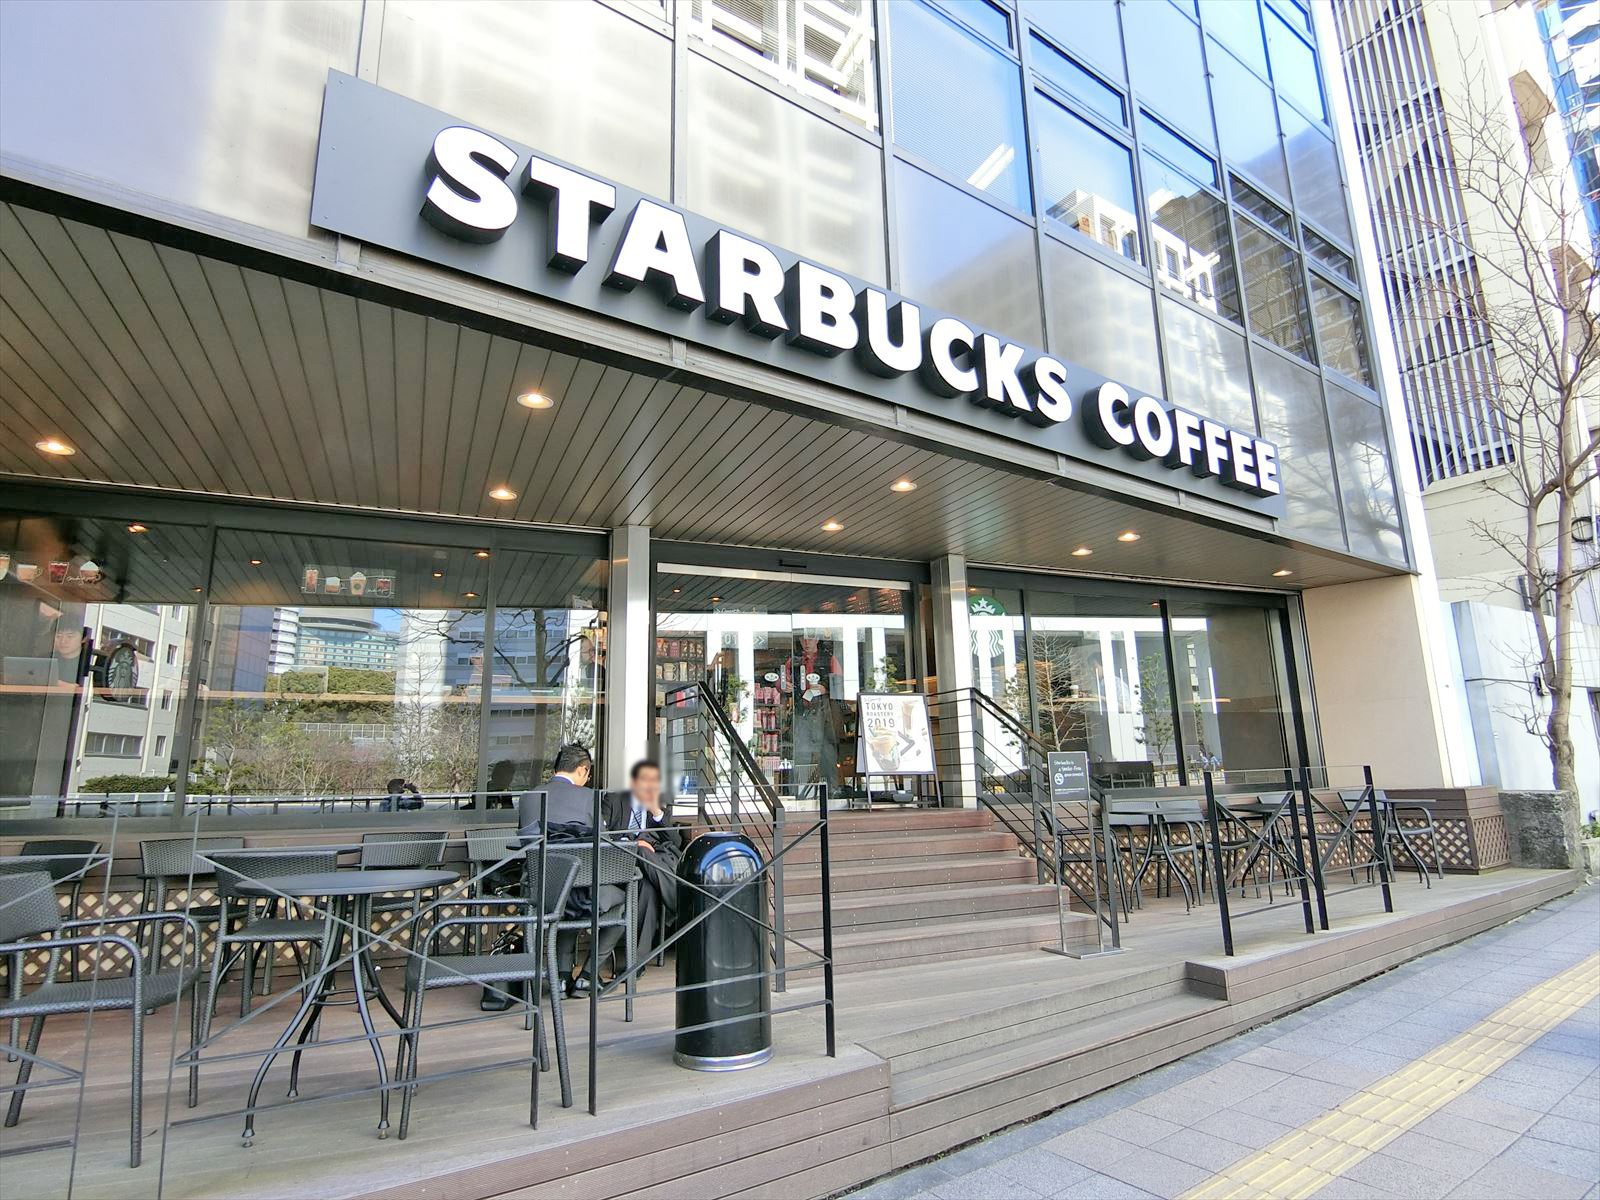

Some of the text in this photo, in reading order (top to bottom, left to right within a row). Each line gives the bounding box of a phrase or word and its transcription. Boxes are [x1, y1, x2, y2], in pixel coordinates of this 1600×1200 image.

[422, 125, 1281, 496] STARBUCKS COFFEE
[865, 702, 893, 710] TOKYO
[867, 717, 895, 728] 2019
